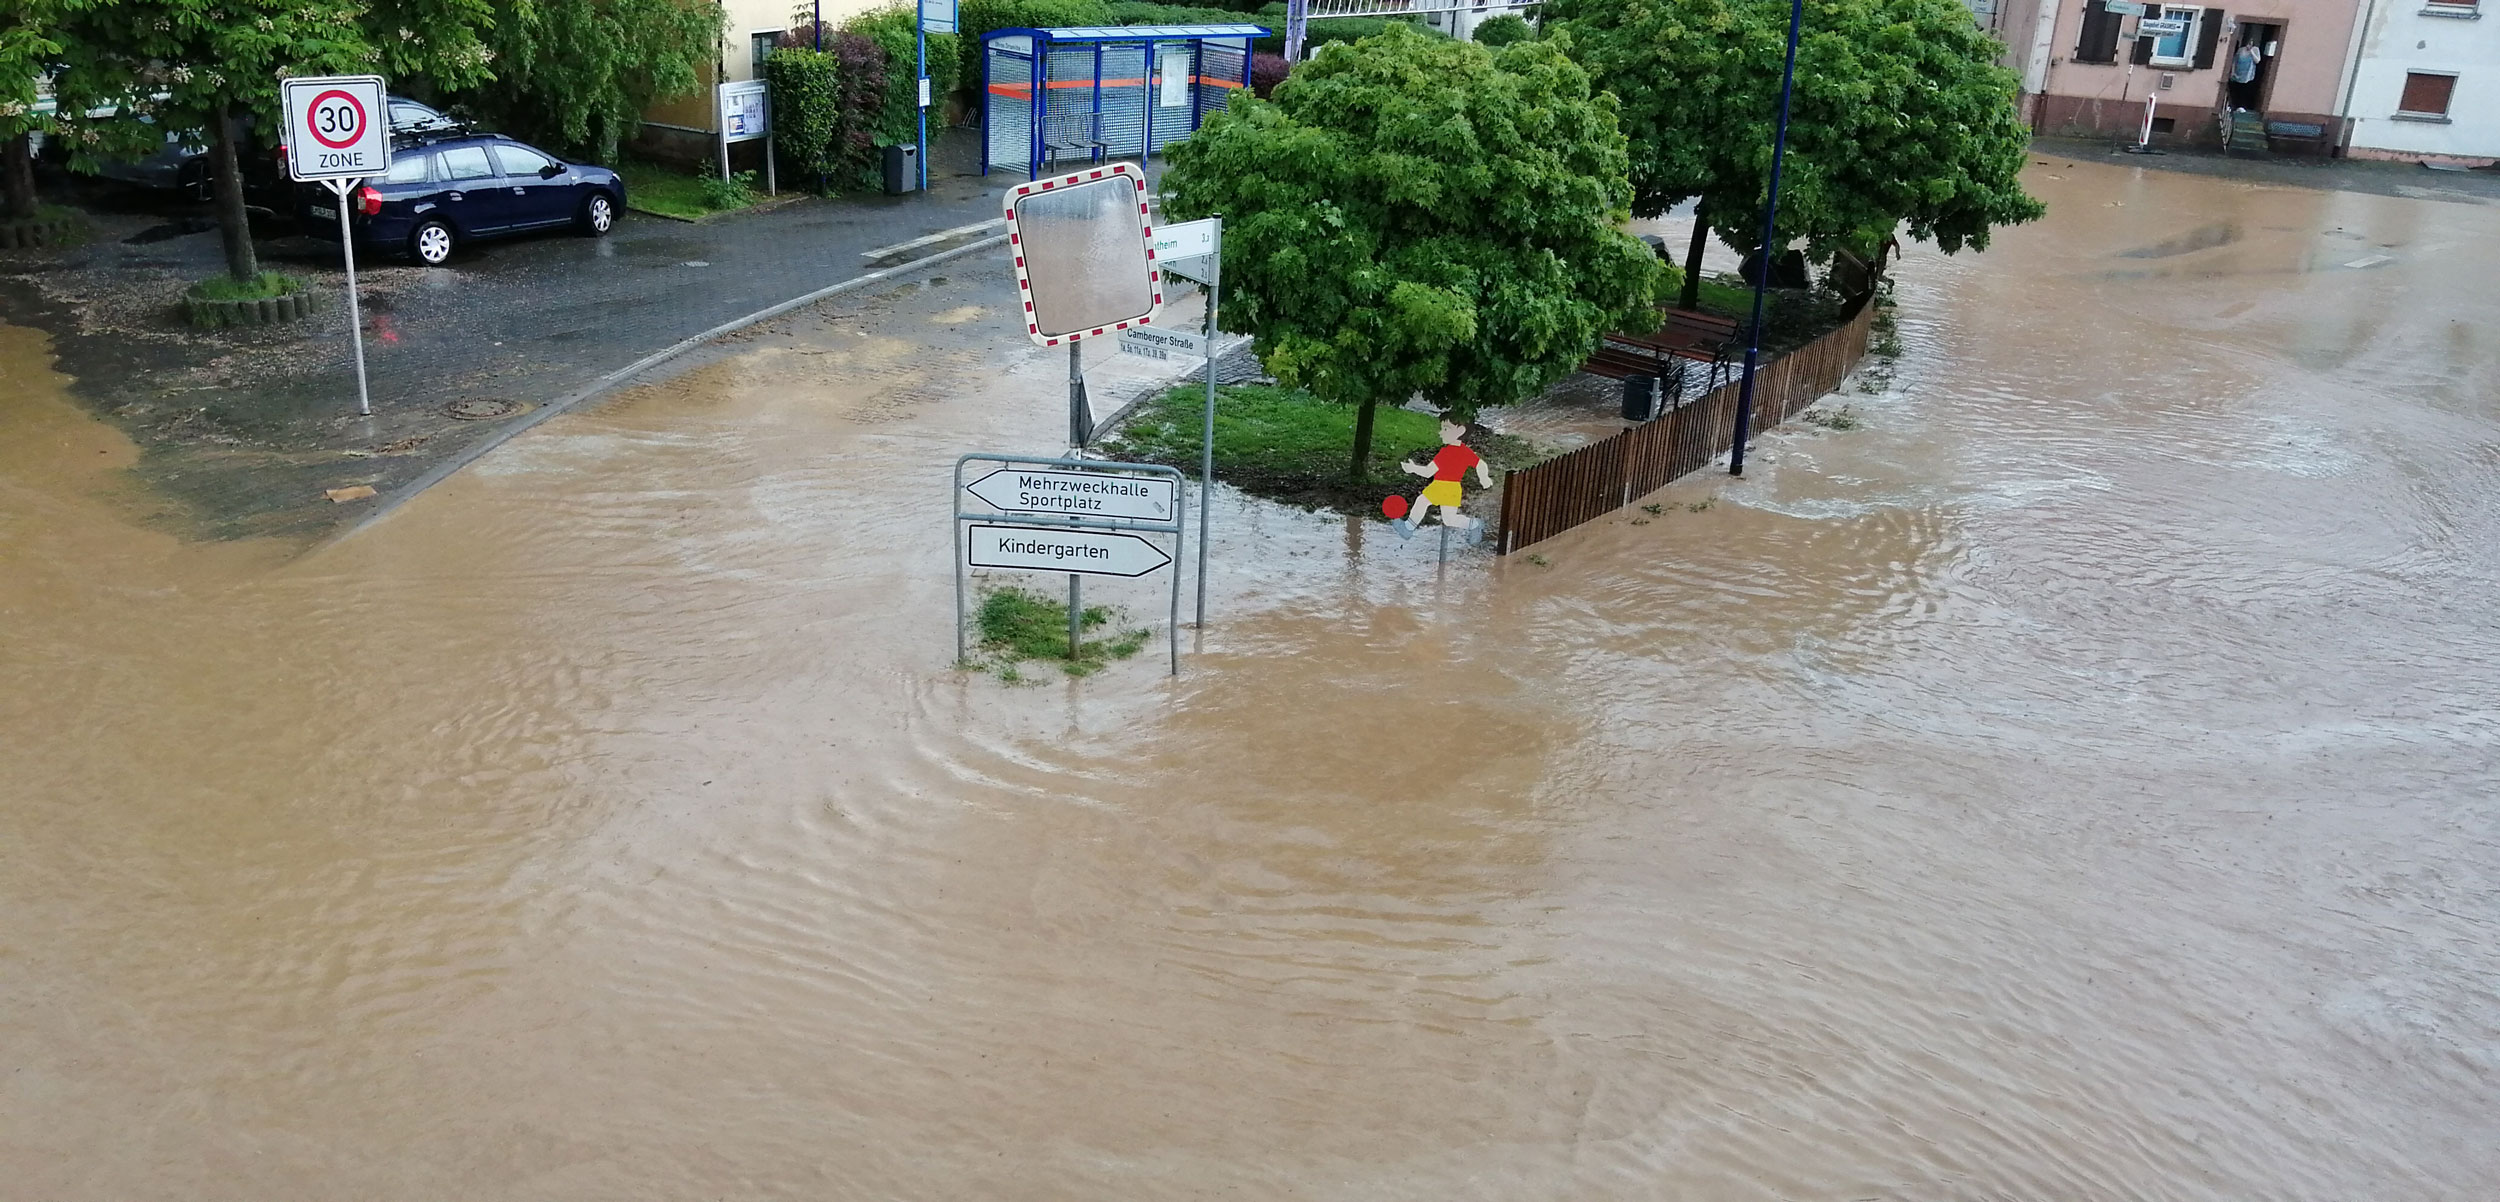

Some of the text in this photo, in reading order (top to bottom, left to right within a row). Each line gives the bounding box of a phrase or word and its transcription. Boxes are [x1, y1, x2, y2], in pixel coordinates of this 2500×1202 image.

[319, 106, 354, 133] 30
[319, 152, 364, 168] ZONE
[1127, 328, 1193, 350] Camberger Straße
[1019, 475, 1149, 497] Mehrzweckhalle
[1019, 492, 1102, 511] Sportplatz
[999, 537, 1109, 560] Kindergarten
